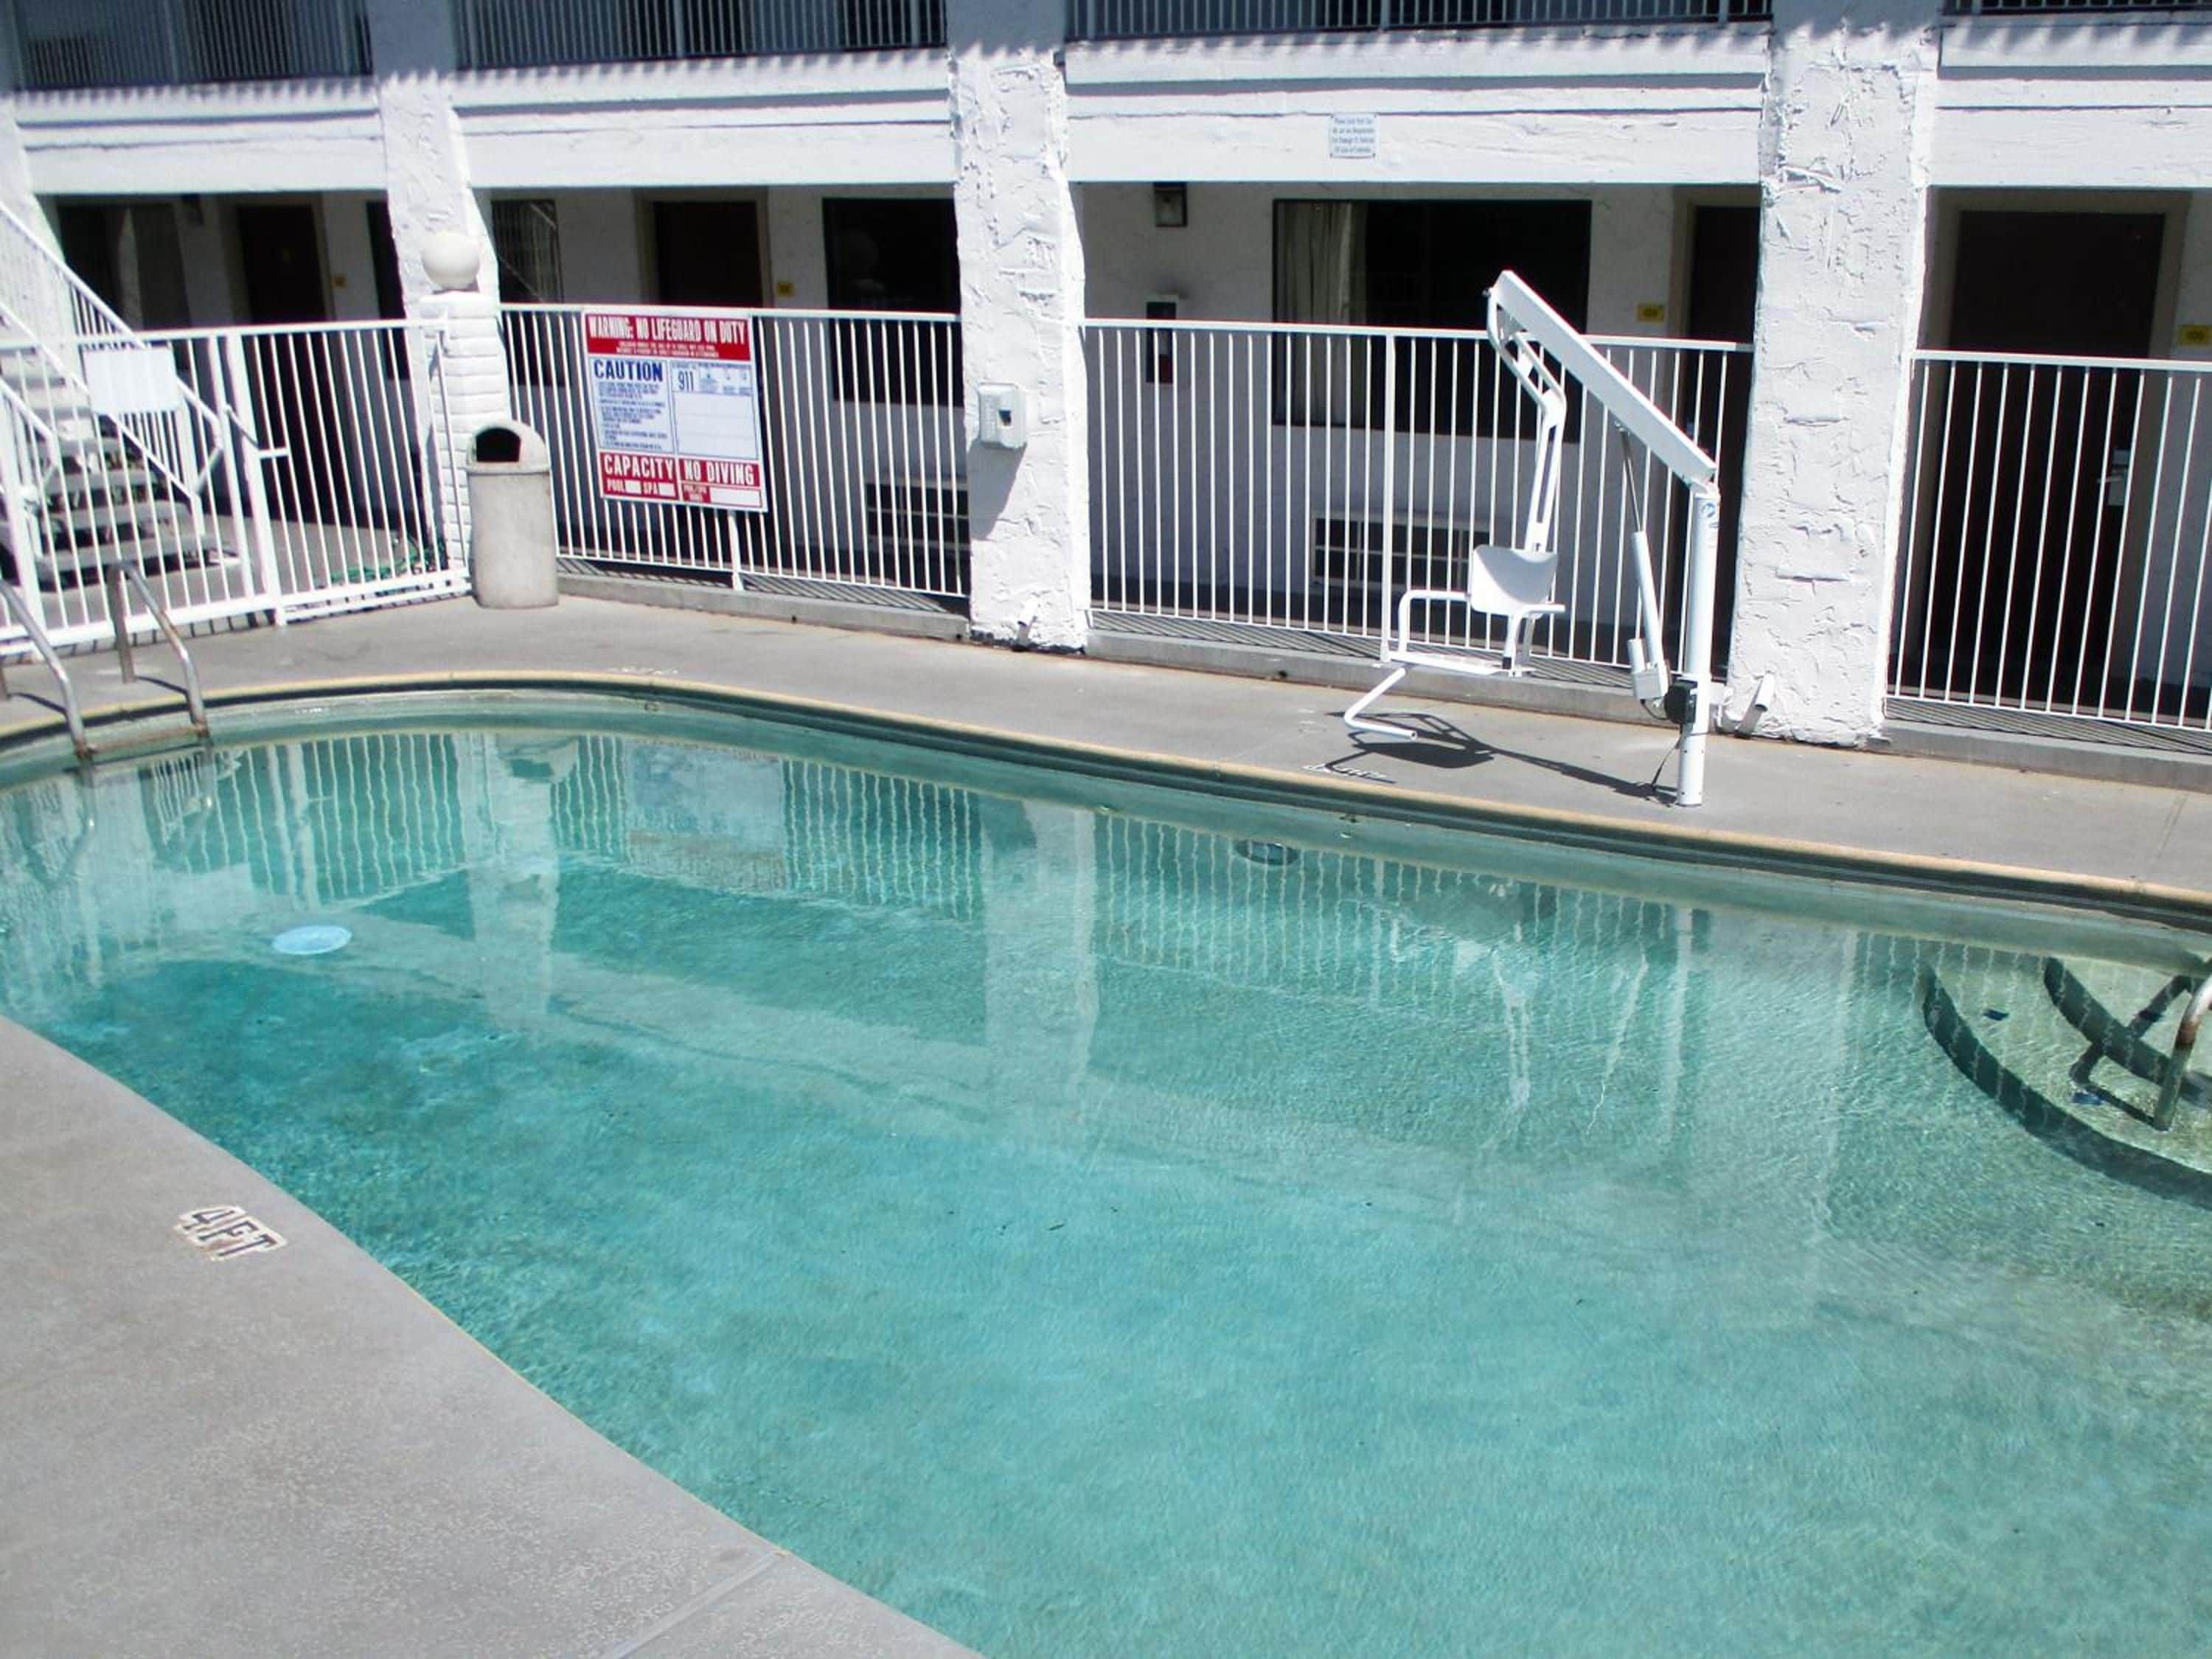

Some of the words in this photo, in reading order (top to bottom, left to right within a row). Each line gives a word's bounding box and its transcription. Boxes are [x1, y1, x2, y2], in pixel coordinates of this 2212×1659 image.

[635, 318, 649, 340] NO
[650, 318, 702, 342] LIFEGUARD
[703, 320, 718, 344] ON
[718, 320, 745, 345] DUTY
[594, 359, 663, 382] CAUTION
[678, 371, 694, 390] 911
[603, 453, 674, 481] CAPACITY
[684, 459, 702, 481] NO
[706, 460, 755, 486] DIVING
